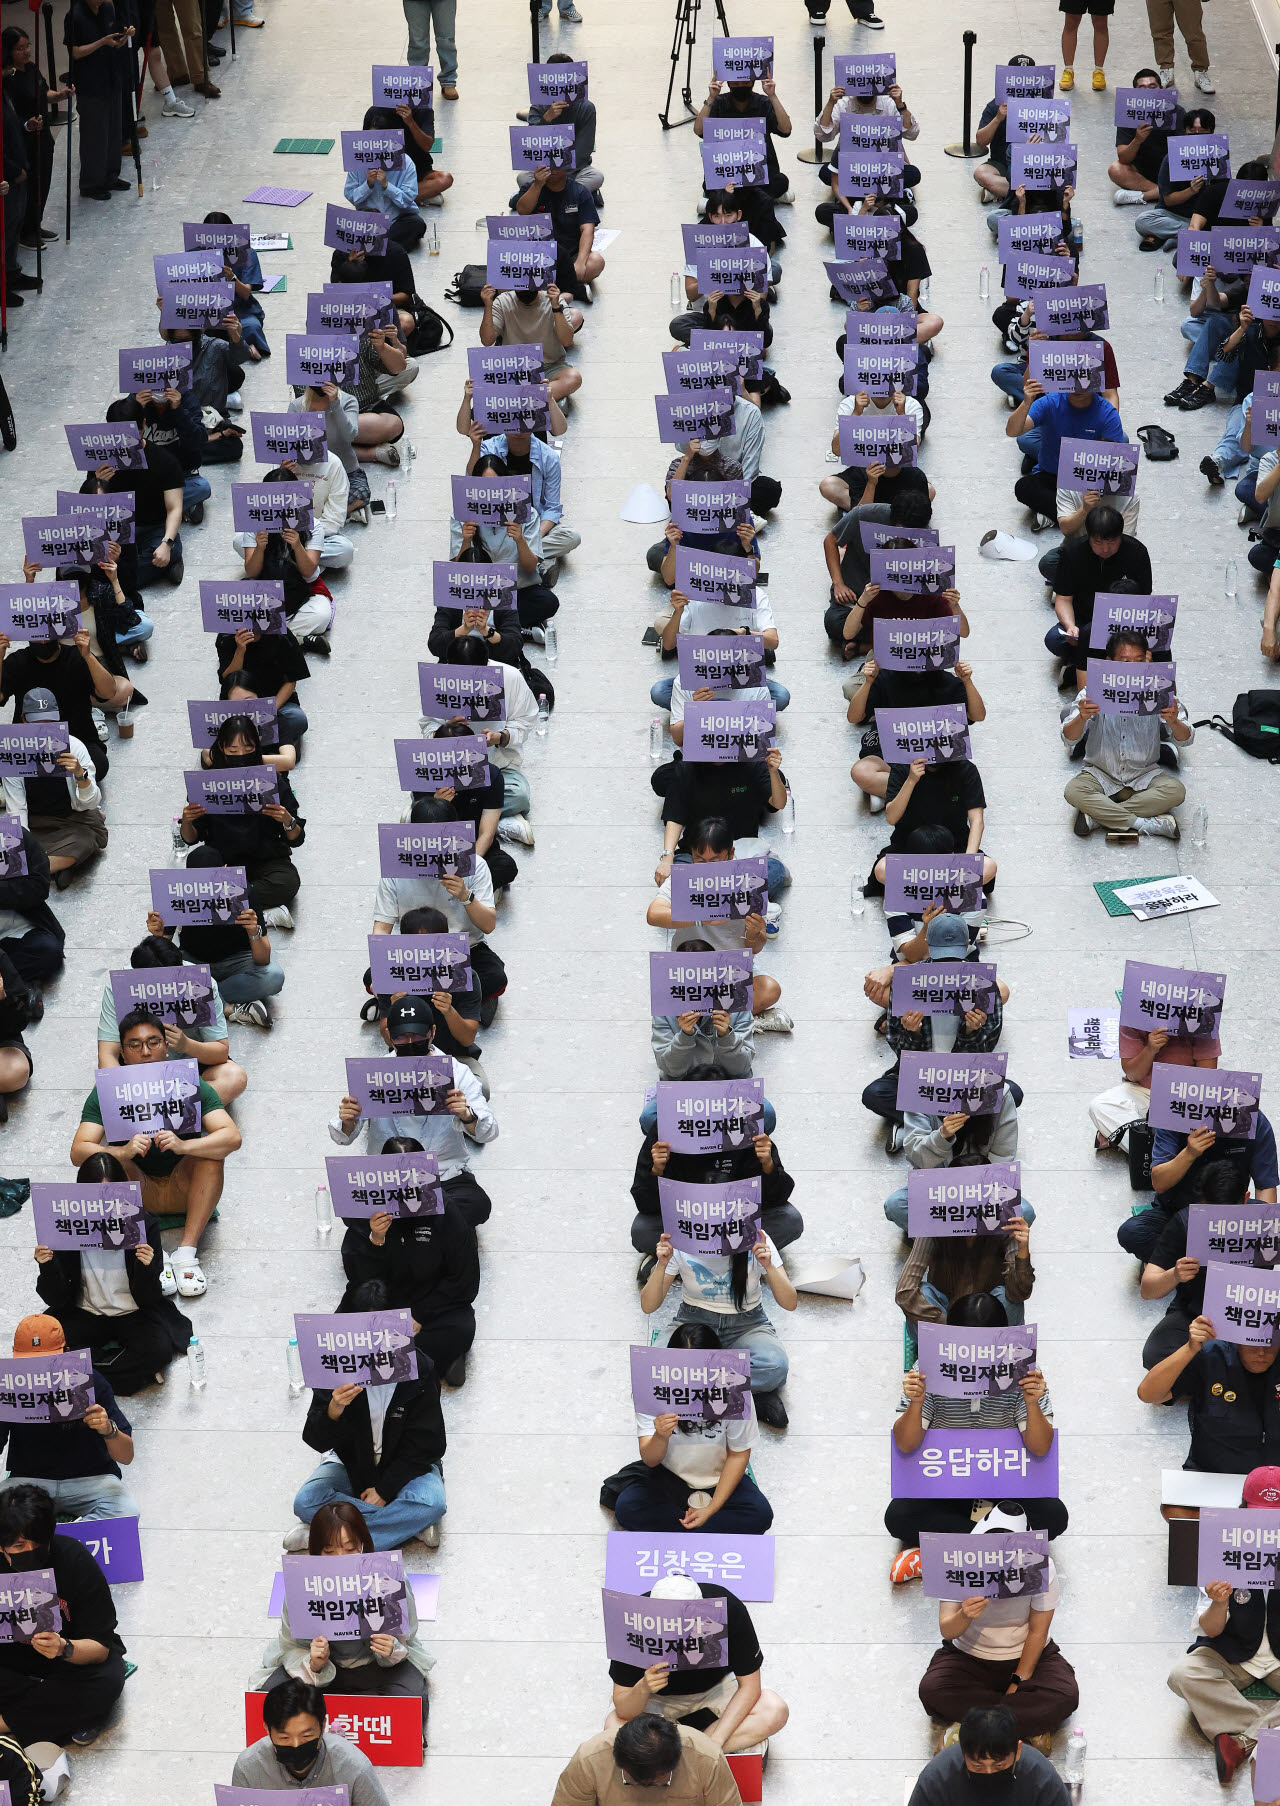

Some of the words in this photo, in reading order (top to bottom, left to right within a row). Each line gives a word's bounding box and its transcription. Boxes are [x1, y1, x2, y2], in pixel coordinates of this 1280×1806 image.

[724, 48, 762, 58] 네이버가
[846, 64, 884, 75] 네이버가
[383, 75, 422, 87] 네이버가
[538, 72, 577, 83] 네이버가
[1126, 98, 1165, 109] 네이버가
[1019, 109, 1058, 120] 네이버가
[353, 139, 392, 151] 네이버가
[1180, 145, 1218, 157] 네이버가
[713, 151, 754, 163] 네이버가
[1024, 154, 1065, 166] 네이버가
[850, 163, 891, 174] 네이버가
[1224, 238, 1269, 250] 네이버가
[500, 252, 545, 265] 네이버가
[710, 258, 754, 270] 네이버가
[1047, 296, 1093, 312] 네이버가
[300, 348, 345, 359] 네이버가
[1042, 353, 1090, 366] 네이버가
[133, 356, 179, 371] 네이버가
[858, 357, 904, 370] 네이버가
[486, 396, 534, 410] 네이버가
[264, 425, 312, 438] 네이버가
[853, 428, 902, 440] 네이버가
[1074, 452, 1123, 468] 네이버가
[247, 494, 297, 506] 네이버가
[466, 488, 516, 502] 네이버가
[686, 493, 736, 507] 네이버가
[38, 525, 91, 541] 네이버가
[690, 561, 740, 582] 네이버가
[886, 559, 939, 572] 네이버가
[448, 573, 502, 586] 네이버가
[10, 595, 64, 610] 네이버가
[216, 593, 268, 607] 네이버가
[889, 630, 944, 645] 네이버가
[693, 649, 748, 663] 네이버가
[890, 645, 945, 659] 책임져라
[695, 664, 750, 678] 책임져라
[434, 678, 487, 693] 네이버가
[1103, 675, 1158, 688] 네이버가
[1103, 688, 1159, 703] 책임져라
[701, 717, 759, 731] 네이버가
[893, 719, 950, 735] 네이버가
[701, 734, 759, 749] 책임져라
[896, 735, 953, 751] 책임져라
[412, 750, 470, 764] 네이버가
[415, 765, 472, 780] 책임져라
[396, 837, 457, 851] 네이버가
[398, 853, 458, 867] 책임져라
[688, 874, 750, 891] 네이버가
[903, 868, 965, 882] 네이버가
[169, 881, 229, 896] 네이버가
[903, 884, 964, 900] 책임져라
[171, 899, 230, 913] 책임져라
[690, 890, 751, 907] 책임져라
[387, 948, 451, 964] 네이버가
[390, 966, 453, 981] 책임져라
[669, 966, 734, 982] 네이버가
[912, 974, 977, 987] 네이버가
[670, 985, 734, 1002] 책임져라
[912, 990, 977, 1002] 책임져라
[1141, 981, 1204, 1004] 네이버가
[1140, 999, 1203, 1022] 책임져라
[366, 1070, 434, 1086] 네이버가
[918, 1068, 986, 1085] 네이버가
[116, 1078, 181, 1102] 네이버가
[369, 1087, 436, 1103] 책임져라
[918, 1086, 986, 1103] 책임져라
[1170, 1082, 1239, 1103] 네이버가
[119, 1100, 185, 1122] 책임져라
[677, 1098, 745, 1116] 네이버가
[1170, 1101, 1238, 1122] 책임져라
[678, 1117, 745, 1137] 책임져라
[348, 1168, 419, 1187] 네이버가
[351, 1187, 422, 1205] 책임져라
[929, 1182, 1002, 1202] 네이버가
[52, 1199, 122, 1216] 네이버가
[676, 1198, 744, 1220] 네이버가
[930, 1201, 1002, 1221] 책임져라
[56, 1218, 125, 1235] 책임져라
[678, 1219, 744, 1240] 책임져라
[1209, 1236, 1280, 1252] 책임져라
[317, 1330, 391, 1351] 네이버가
[939, 1343, 1015, 1362] 네이버가
[321, 1352, 394, 1373] 책임져라
[651, 1366, 729, 1384] 네이버가
[940, 1363, 1014, 1382] 책임져라
[0, 1391, 72, 1406] 책임져라
[654, 1385, 728, 1404] 책임져라
[919, 1448, 1030, 1477] 응답하라
[79, 1537, 112, 1564] 가
[635, 1550, 745, 1579] 김창욱은
[944, 1549, 1025, 1568] 네이버가
[304, 1573, 381, 1596] 네이버가
[946, 1569, 1025, 1587] 책임져라
[308, 1597, 386, 1620] 책임져라
[624, 1612, 703, 1635] 네이버가
[627, 1633, 704, 1656] 책임져라
